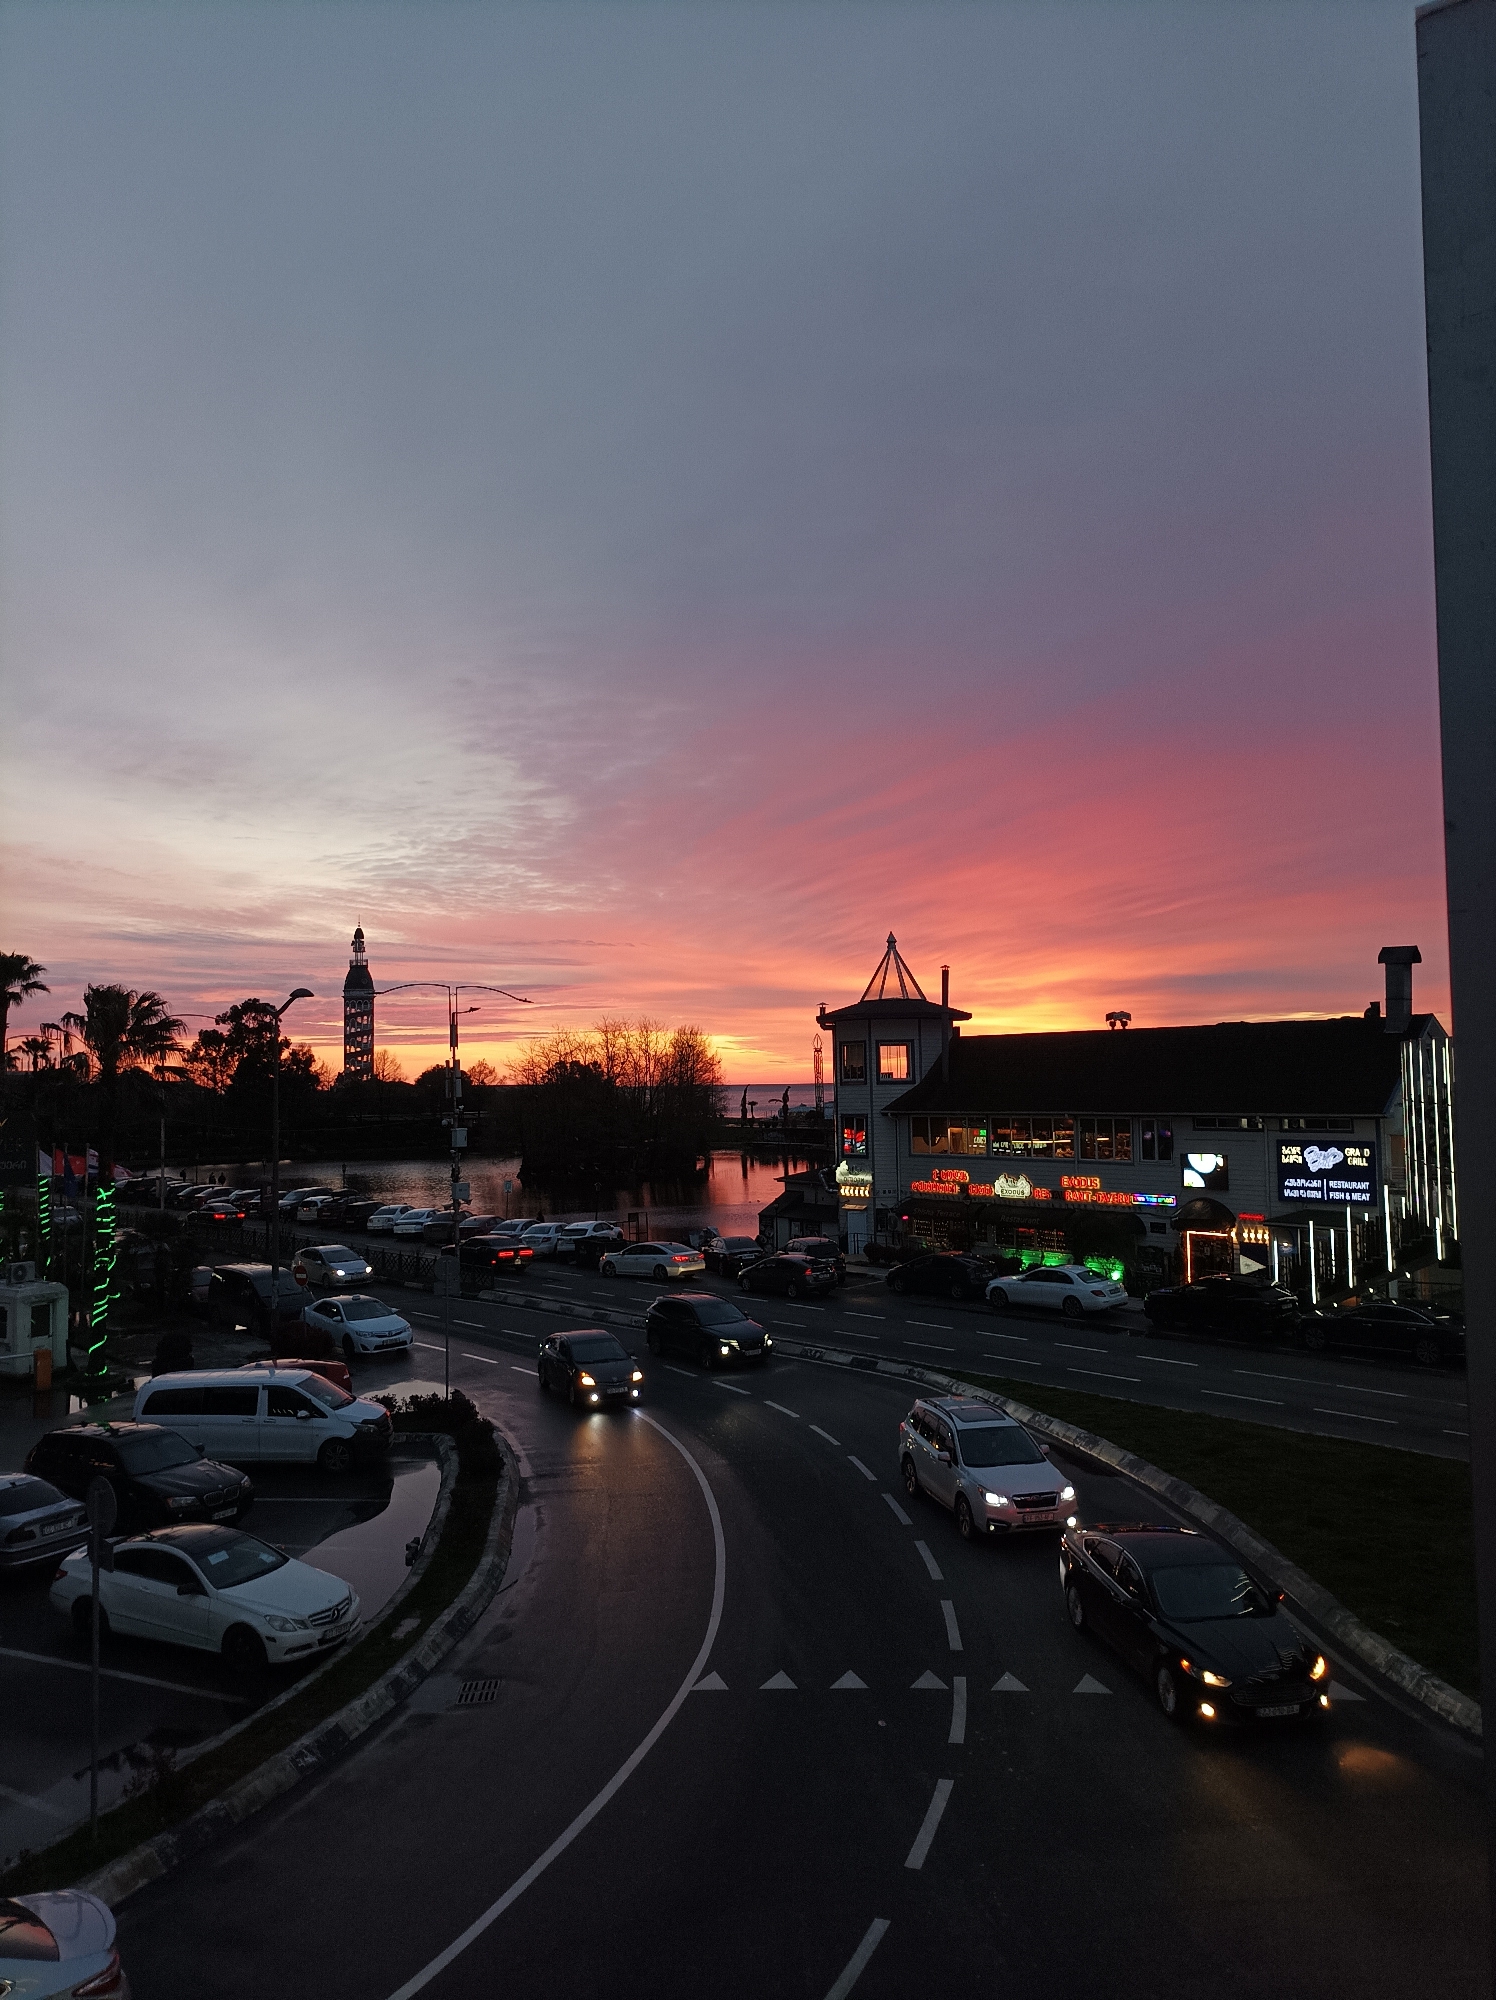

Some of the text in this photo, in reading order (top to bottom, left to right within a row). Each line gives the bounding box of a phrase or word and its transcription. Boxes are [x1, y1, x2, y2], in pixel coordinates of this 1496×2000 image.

[1344, 1147, 1370, 1157] GRAD
[1347, 1157, 1369, 1167] GRILL
[1060, 1175, 1101, 1190] EXODUS
[1328, 1180, 1370, 1190] RESTAURANT
[1329, 1191, 1345, 1200] FISH
[1351, 1192, 1371, 1202] MEAT
